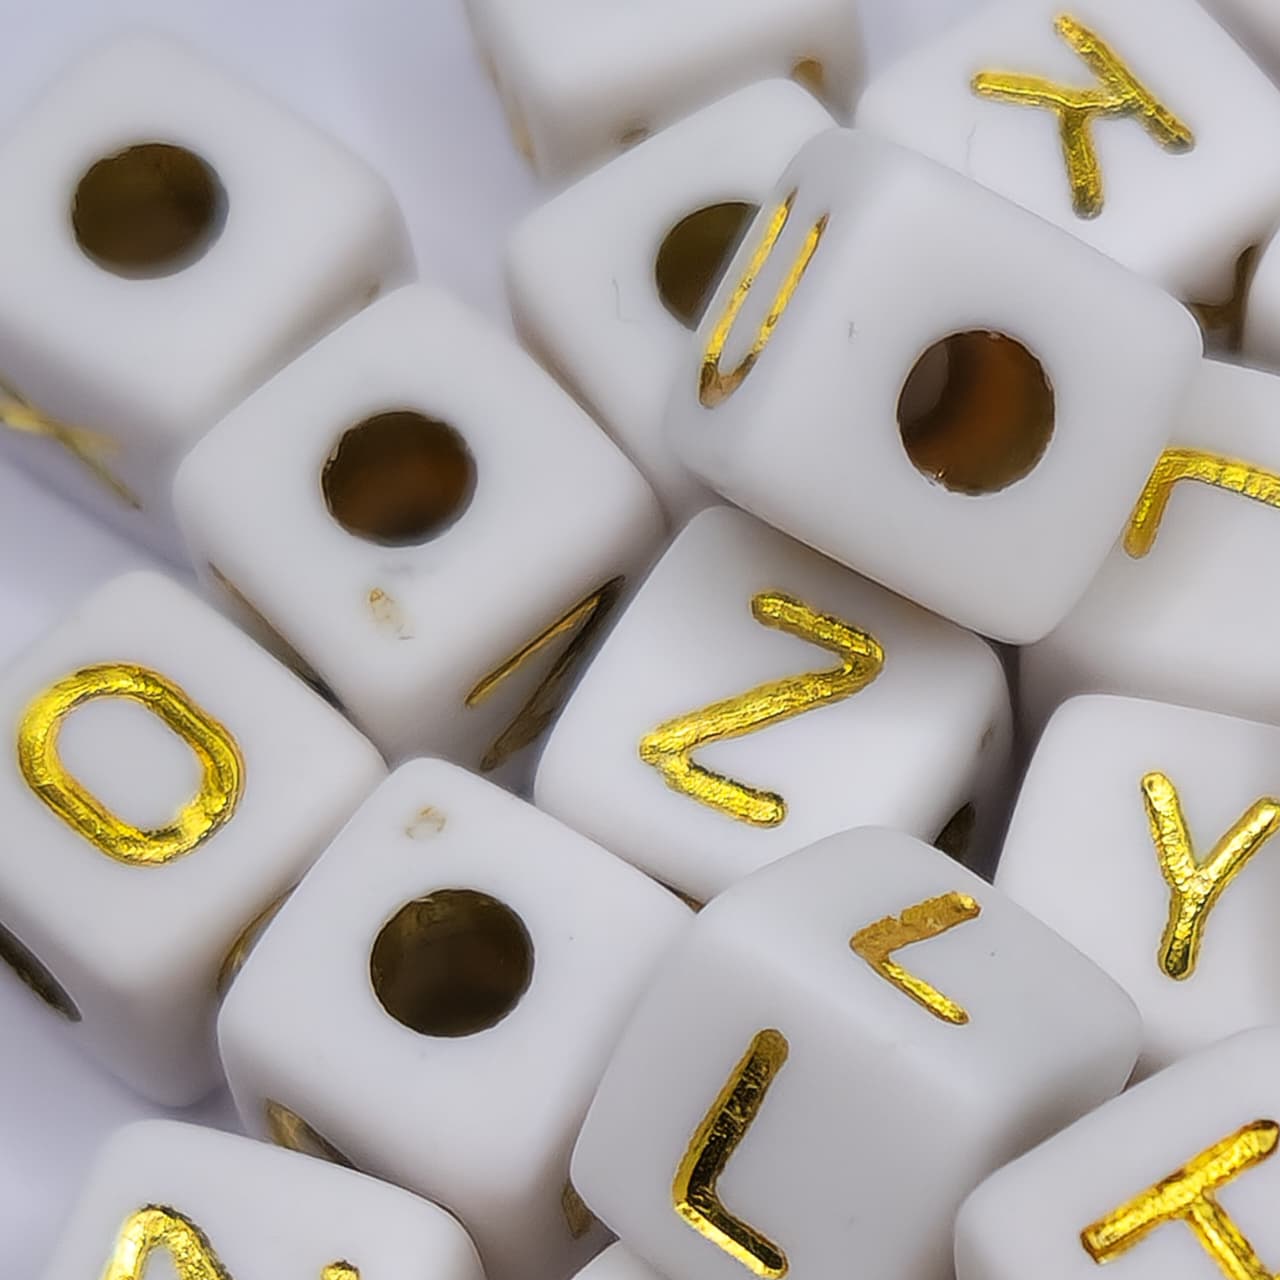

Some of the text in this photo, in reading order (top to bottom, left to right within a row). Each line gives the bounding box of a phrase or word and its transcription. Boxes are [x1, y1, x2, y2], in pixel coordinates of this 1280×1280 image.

[973, 12, 1194, 219] K
[16, 660, 246, 866] O
[672, 1028, 789, 1280] L
